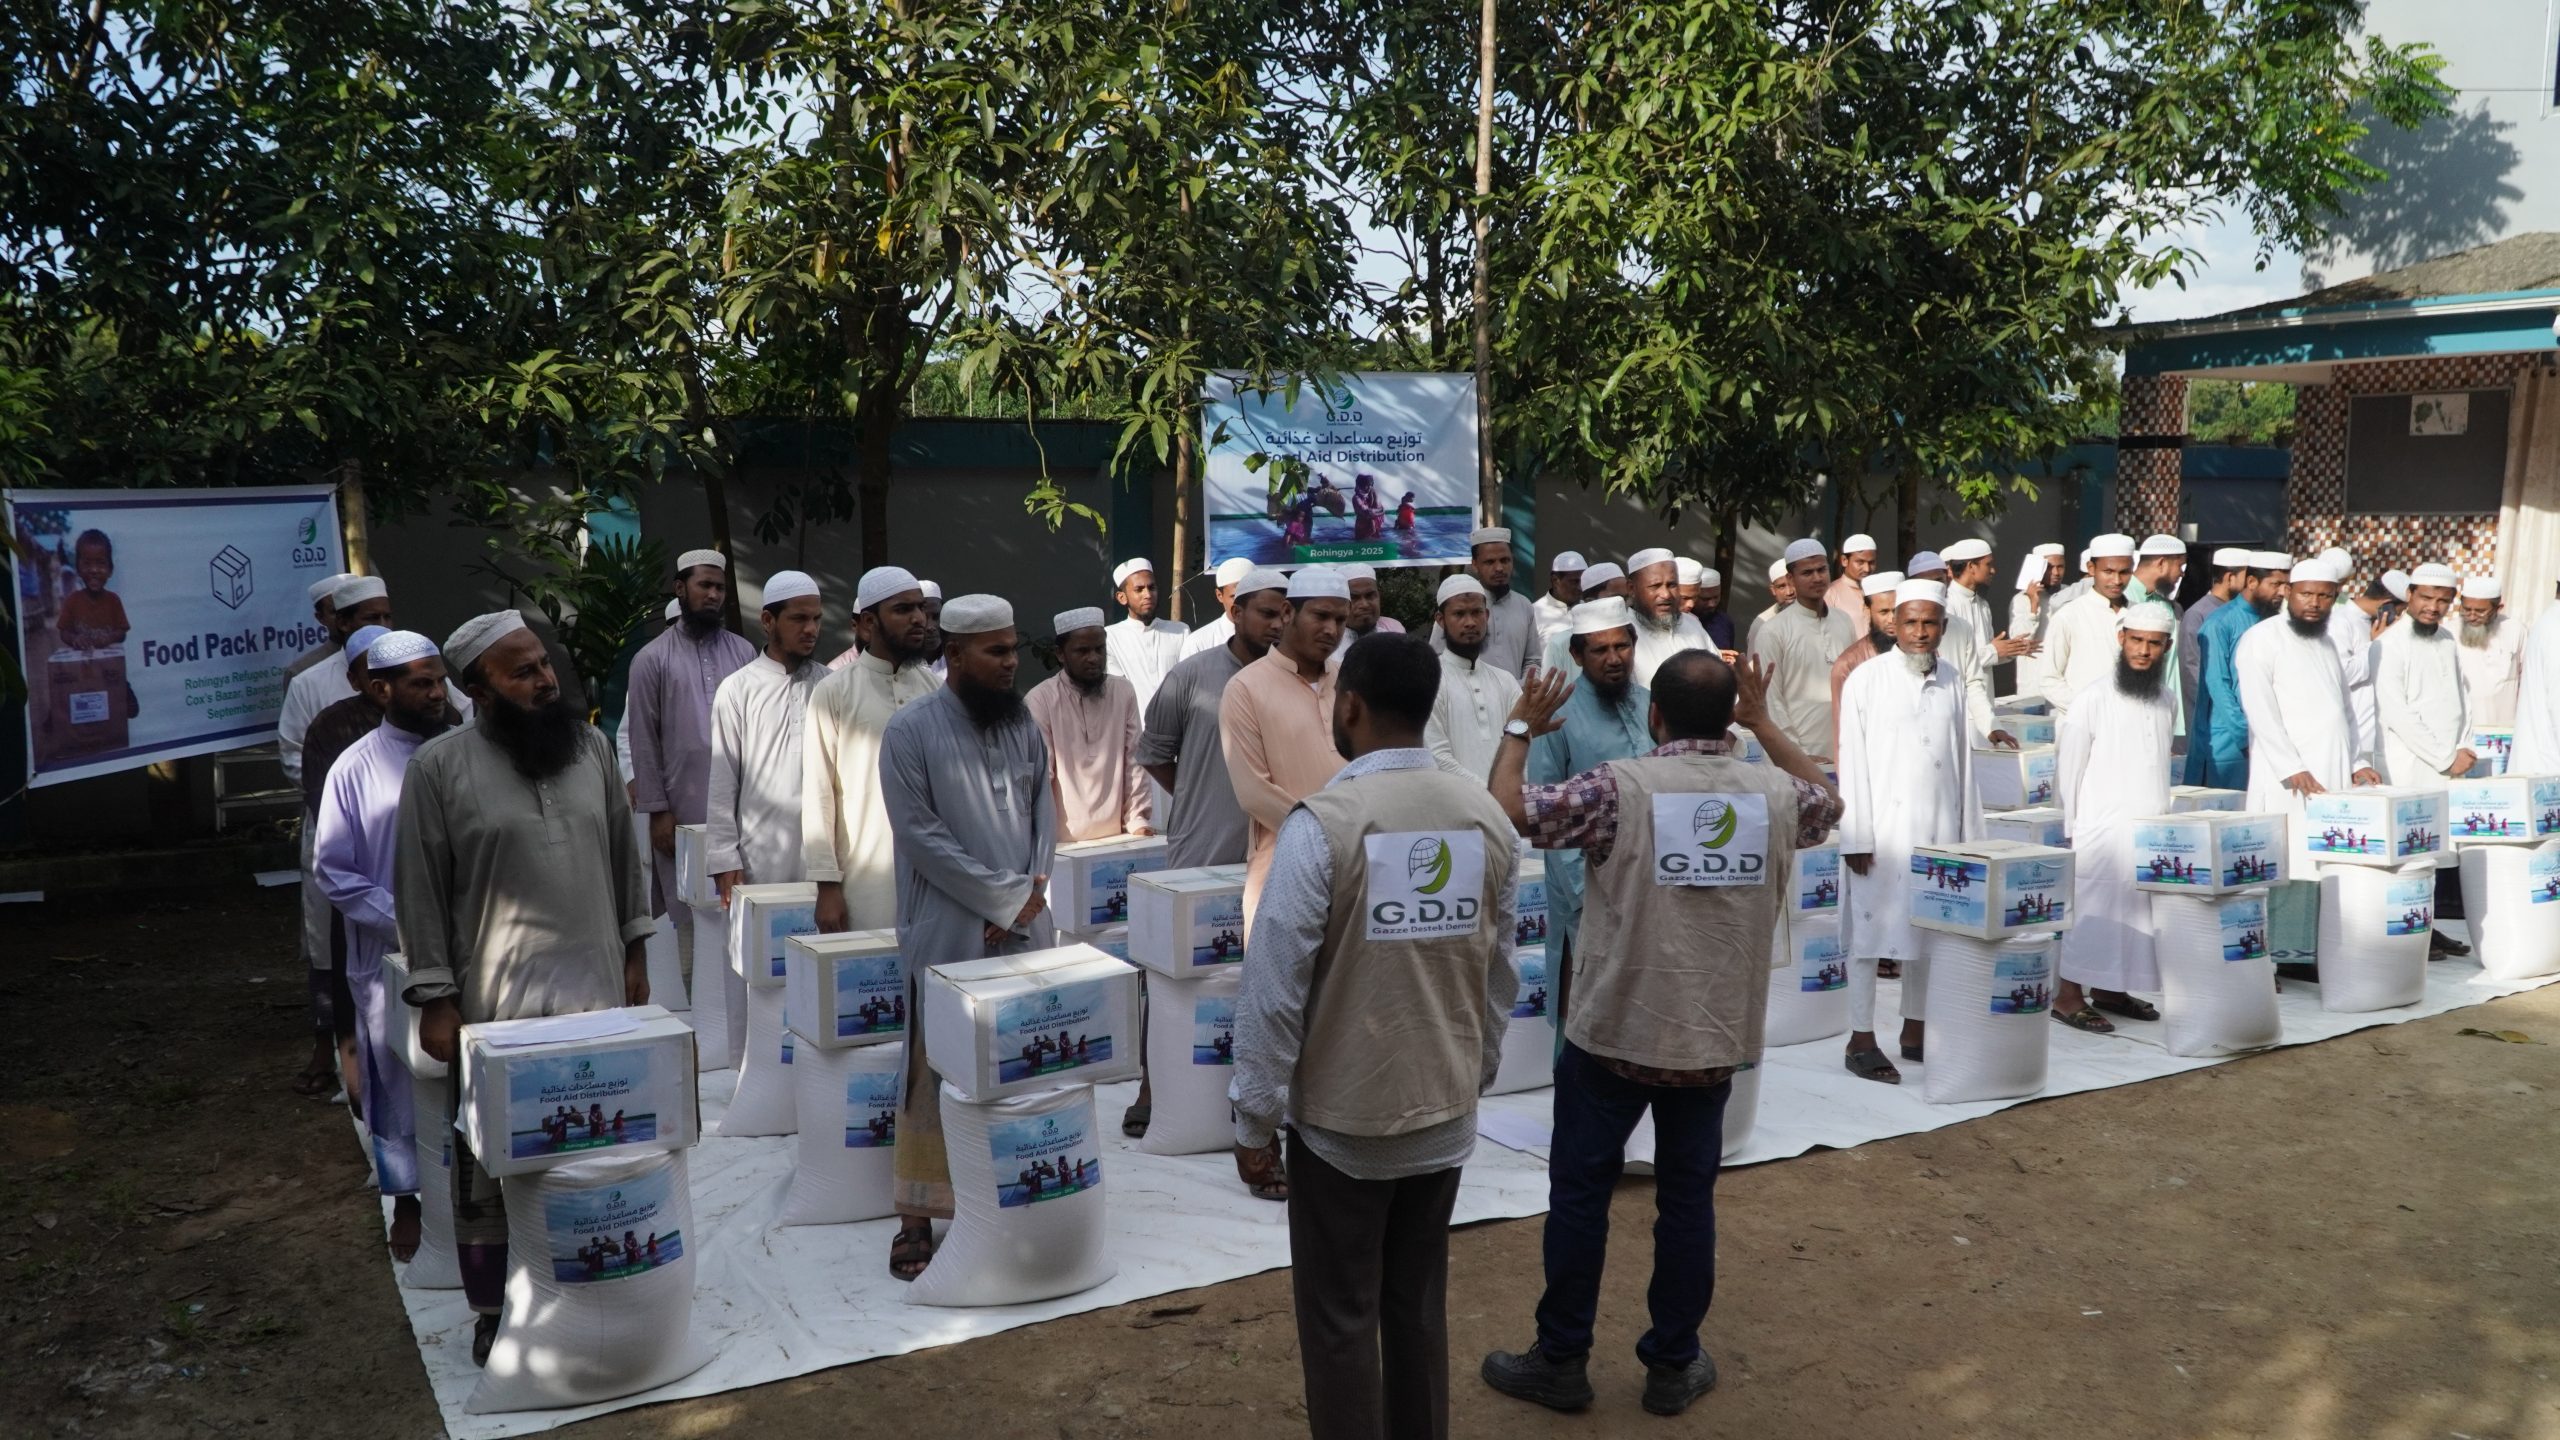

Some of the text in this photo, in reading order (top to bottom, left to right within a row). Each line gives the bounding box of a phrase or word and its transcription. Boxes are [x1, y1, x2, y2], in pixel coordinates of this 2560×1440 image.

[1316, 430, 1383, 445] مساعدات
[1388, 432, 1422, 449] توزيع
[1306, 451, 1332, 462] Aid
[1337, 450, 1424, 462] Distribution
[292, 546, 326, 563] G.D.D
[1310, 549, 1354, 558] Rohingya
[1361, 547, 1384, 556] 2025
[142, 622, 328, 667] Food Pack Projec
[184, 676, 230, 690] Rohingya
[232, 670, 269, 682] Refugee
[185, 694, 213, 706] Cox's
[1660, 853, 1763, 874] G.D.D
[1372, 898, 1478, 925] G.D.D
[1411, 924, 1444, 932] Destek
[1020, 1026, 1036, 1034] Food
[1052, 1016, 1090, 1028] Distribution
[563, 1093, 578, 1101] Aid
[580, 1088, 630, 1100] Distribution
[1016, 1152, 1034, 1160] Food
[1049, 1139, 1084, 1153] Distribution
[574, 1210, 658, 1235] Food Aid Distribution
